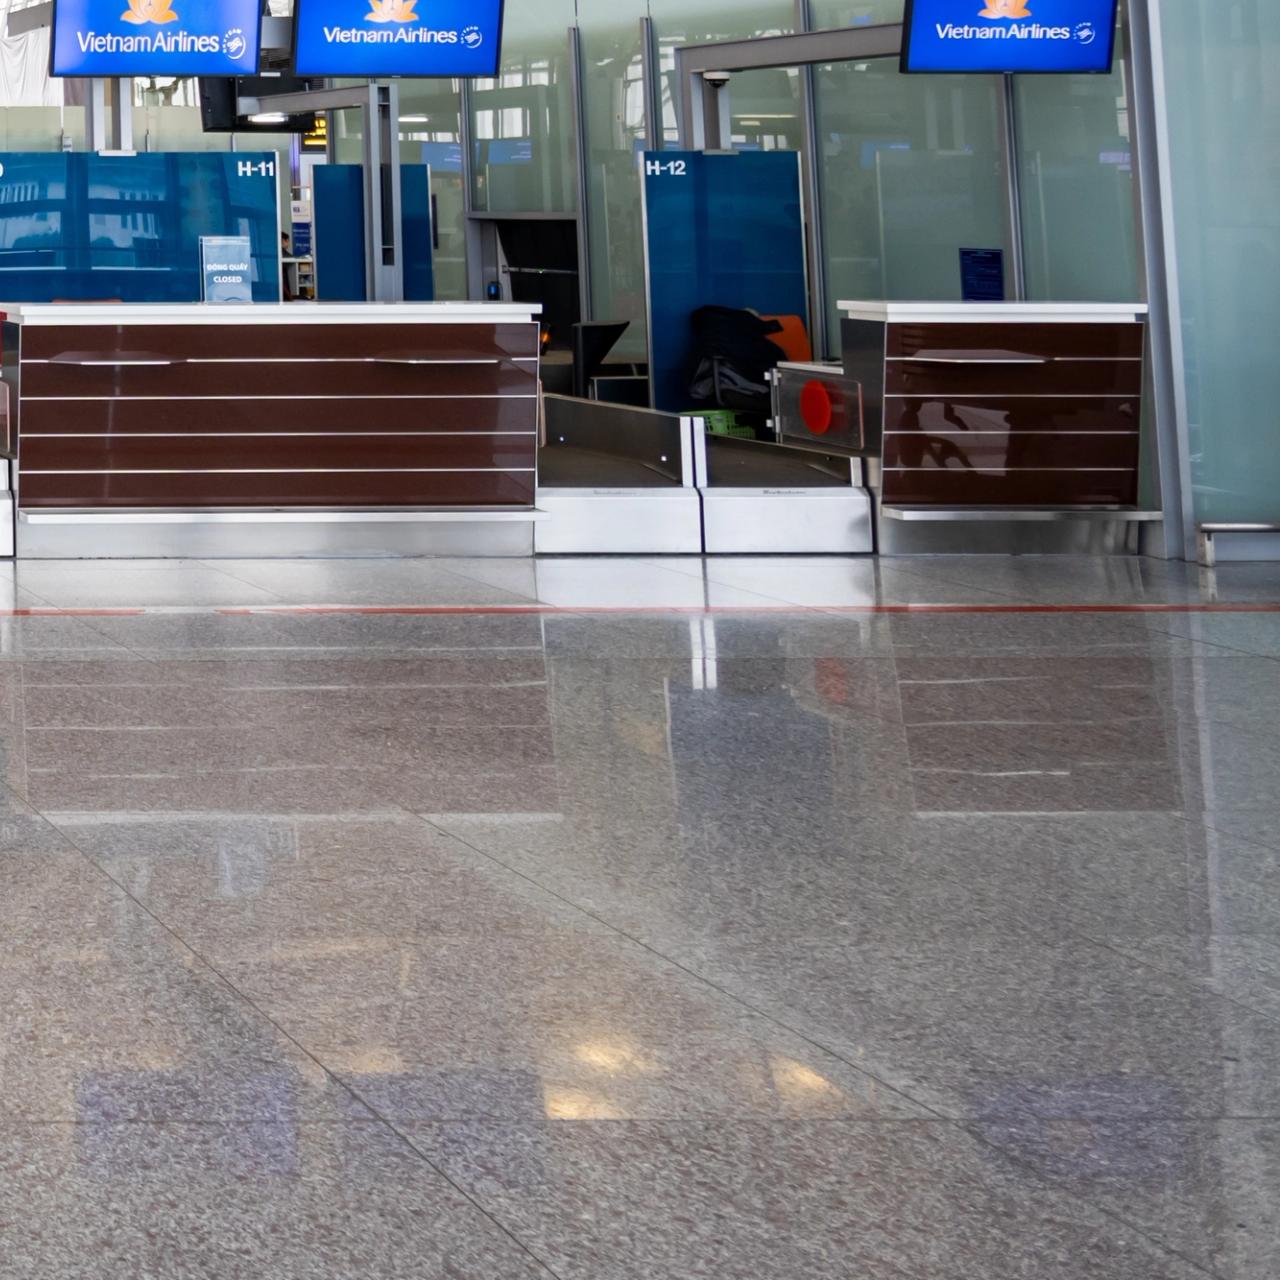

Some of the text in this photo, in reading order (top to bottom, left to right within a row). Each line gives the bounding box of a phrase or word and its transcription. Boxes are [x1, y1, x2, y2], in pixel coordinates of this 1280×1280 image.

[323, 26, 393, 44] Vietnam
[394, 26, 458, 44] Airlines
[936, 23, 1006, 40] Vietnam
[1007, 22, 1070, 39] Airlines
[77, 30, 151, 53] Vietnam
[152, 30, 220, 53] Airlines
[237, 160, 274, 177] H-11
[646, 160, 687, 176] H-12
[213, 275, 242, 283] CLOSED
